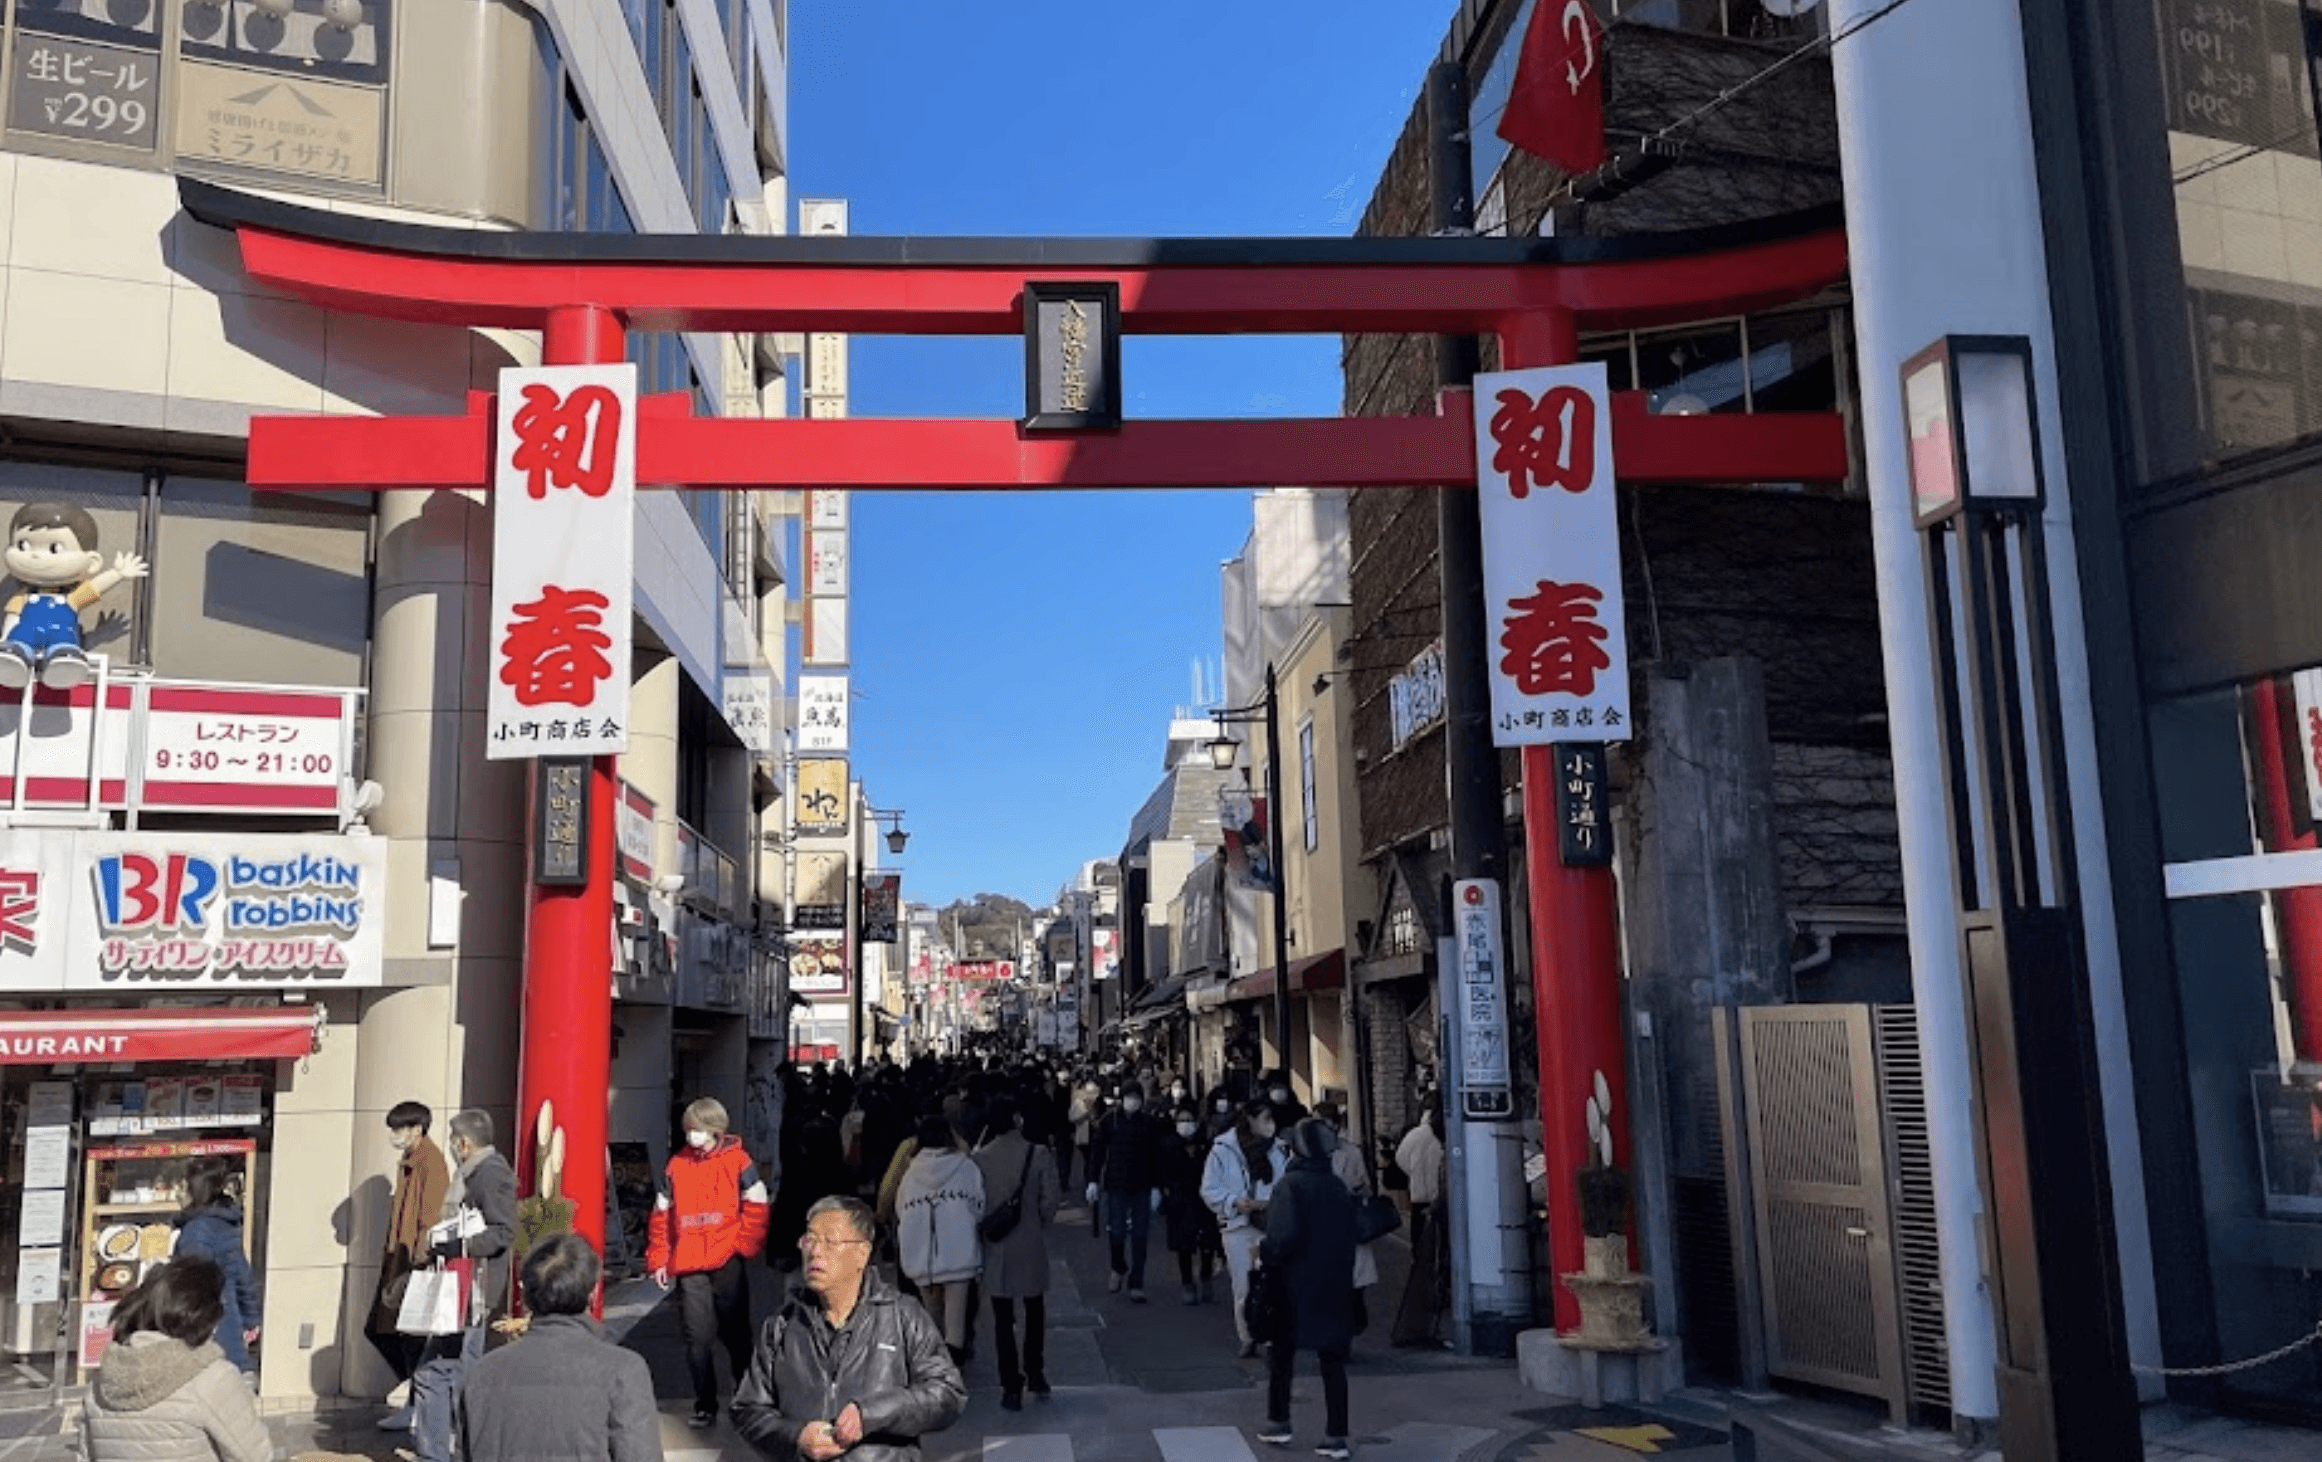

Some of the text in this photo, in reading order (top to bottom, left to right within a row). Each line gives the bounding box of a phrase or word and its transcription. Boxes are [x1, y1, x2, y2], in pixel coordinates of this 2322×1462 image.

[27, 48, 148, 91] 生ビール
[208, 127, 351, 172] ミライザカ
[500, 383, 621, 707] 初春
[1490, 384, 1611, 698] 初春
[196, 722, 299, 744] レストラン
[493, 717, 623, 742] 小町商店会
[1499, 705, 1624, 731] 小町商店会
[1566, 754, 1598, 850] 小町通り
[99, 853, 218, 926] BR
[230, 855, 359, 887] baskin
[230, 896, 359, 927] robbins
[104, 939, 345, 967] サーティワン アイスクリーム
